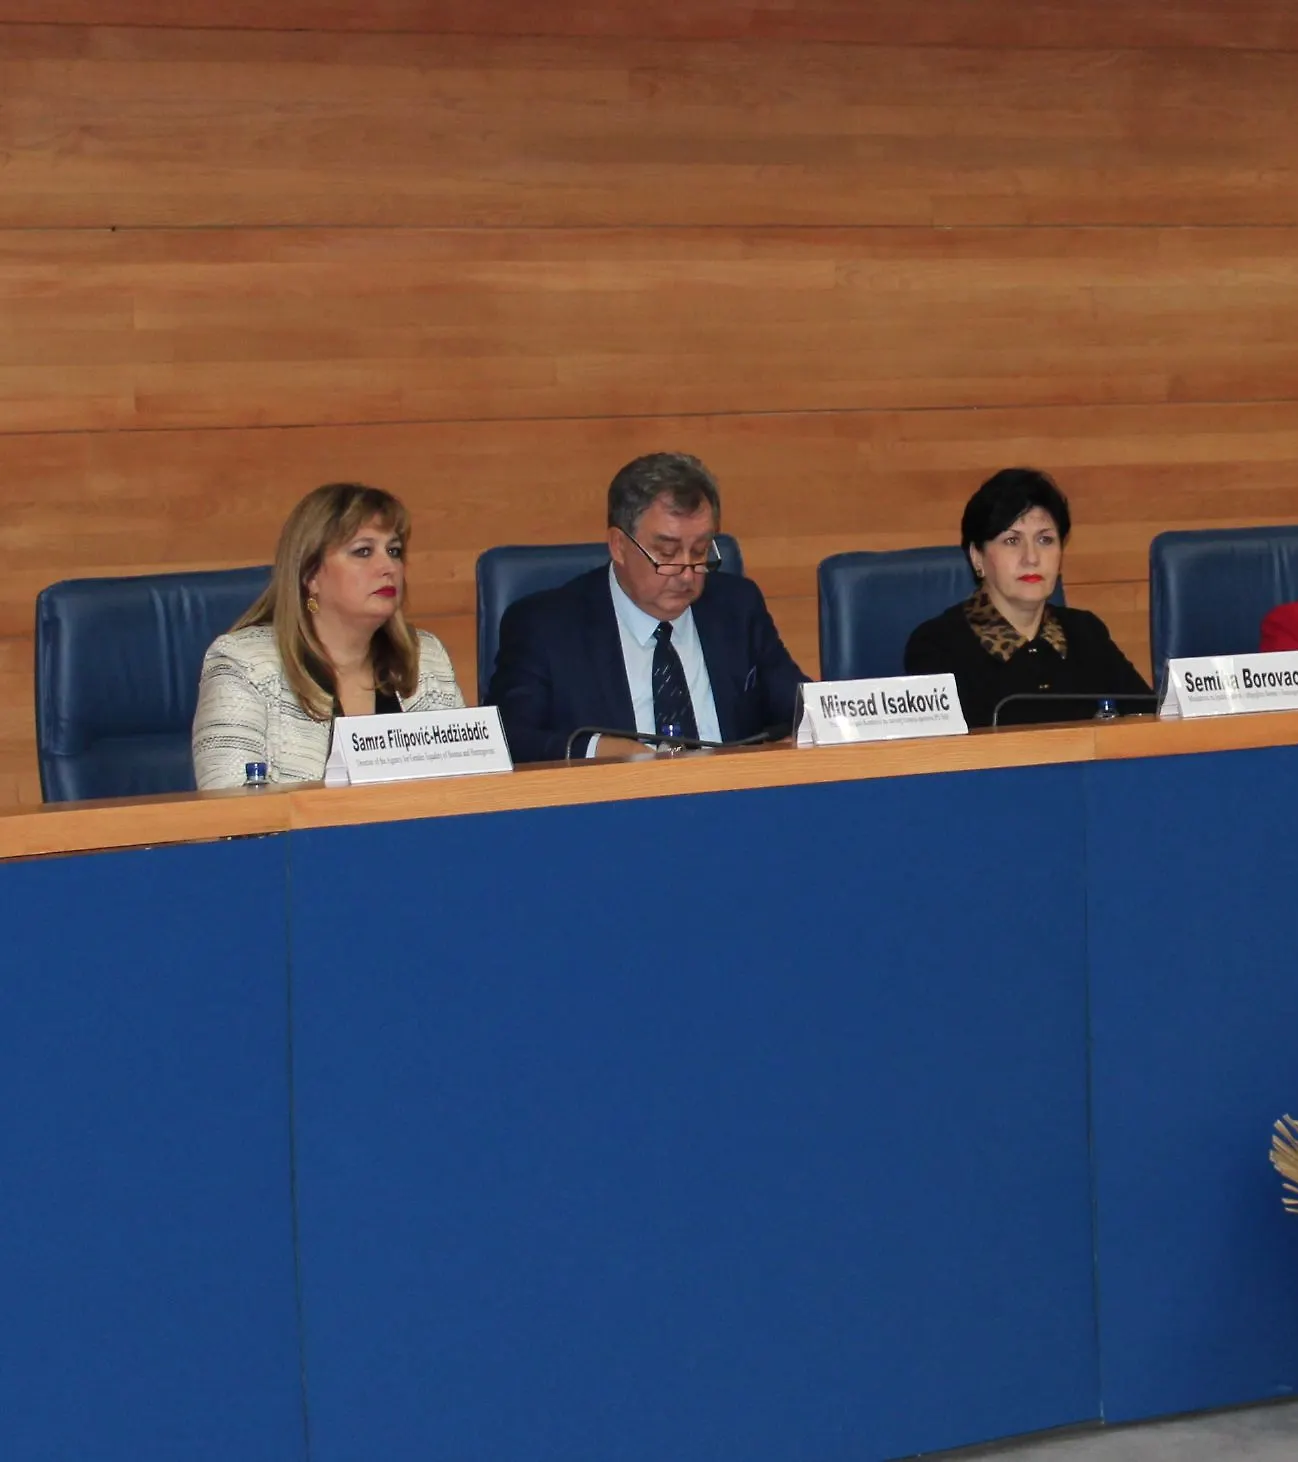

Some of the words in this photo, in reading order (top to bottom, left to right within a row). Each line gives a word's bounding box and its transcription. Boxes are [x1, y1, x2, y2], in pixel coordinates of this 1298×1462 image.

[1184, 670, 1240, 693] Semia
[819, 692, 878, 719] Mirsad
[881, 687, 950, 715] Isaković
[351, 732, 386, 752] Samra
[387, 720, 490, 751] Filipović-Hadžiabdić
